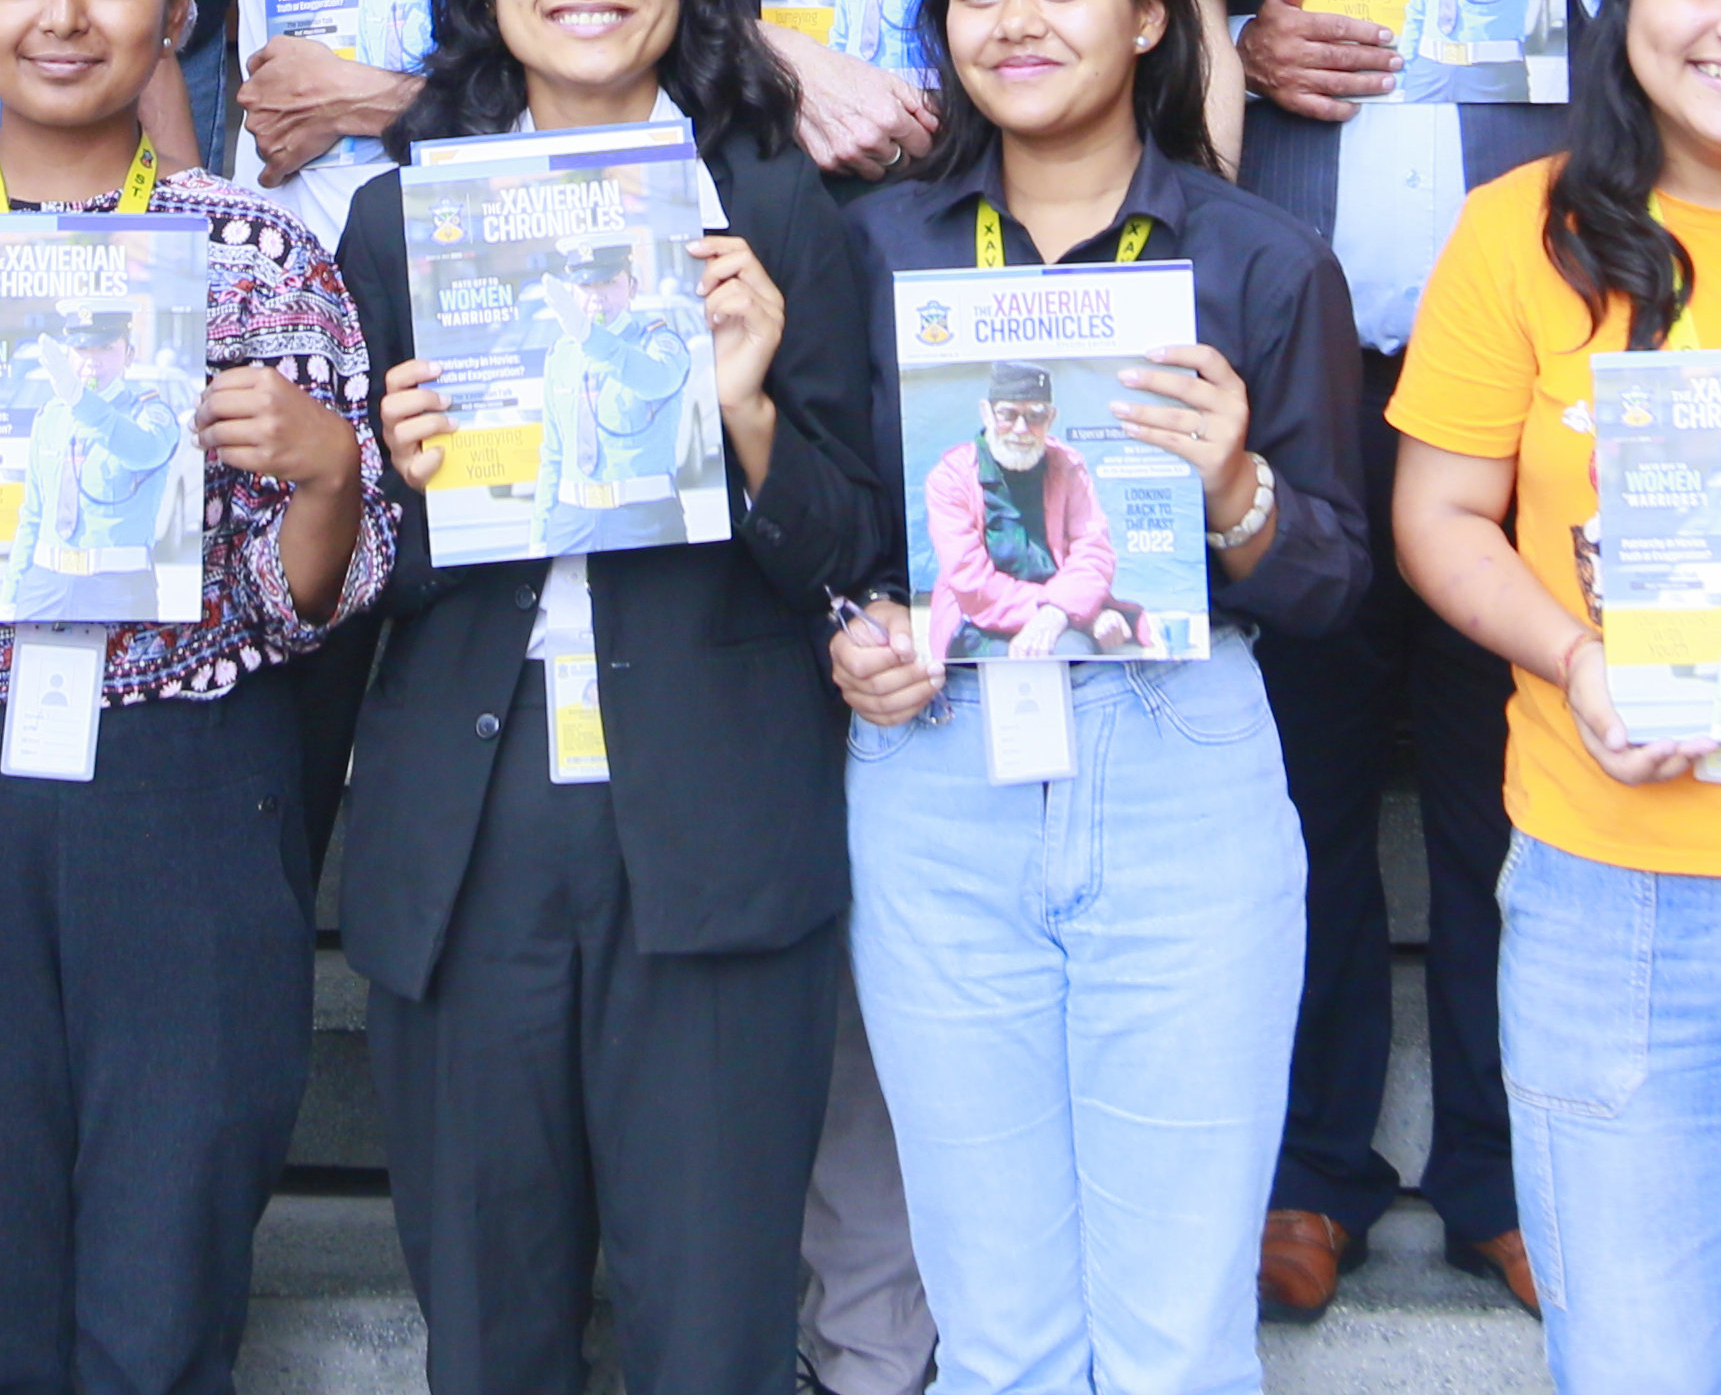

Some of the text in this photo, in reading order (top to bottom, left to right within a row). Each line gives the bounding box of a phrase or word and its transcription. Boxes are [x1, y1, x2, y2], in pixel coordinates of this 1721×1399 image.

[1343, 2, 1370, 15] with
[482, 180, 620, 216] THE XAVIERIAN
[483, 206, 626, 243] CHRONICLES
[4, 245, 126, 272] XAVIERIAN
[439, 284, 513, 312] WOMEN
[437, 307, 519, 327] 'WARRIORS'!
[490, 354, 520, 365] Movies:
[468, 366, 525, 382] Exaggeration?
[450, 429, 523, 450] Journeying
[470, 448, 499, 463] with
[466, 462, 505, 480] Youth
[1626, 470, 1702, 492] WOMEN
